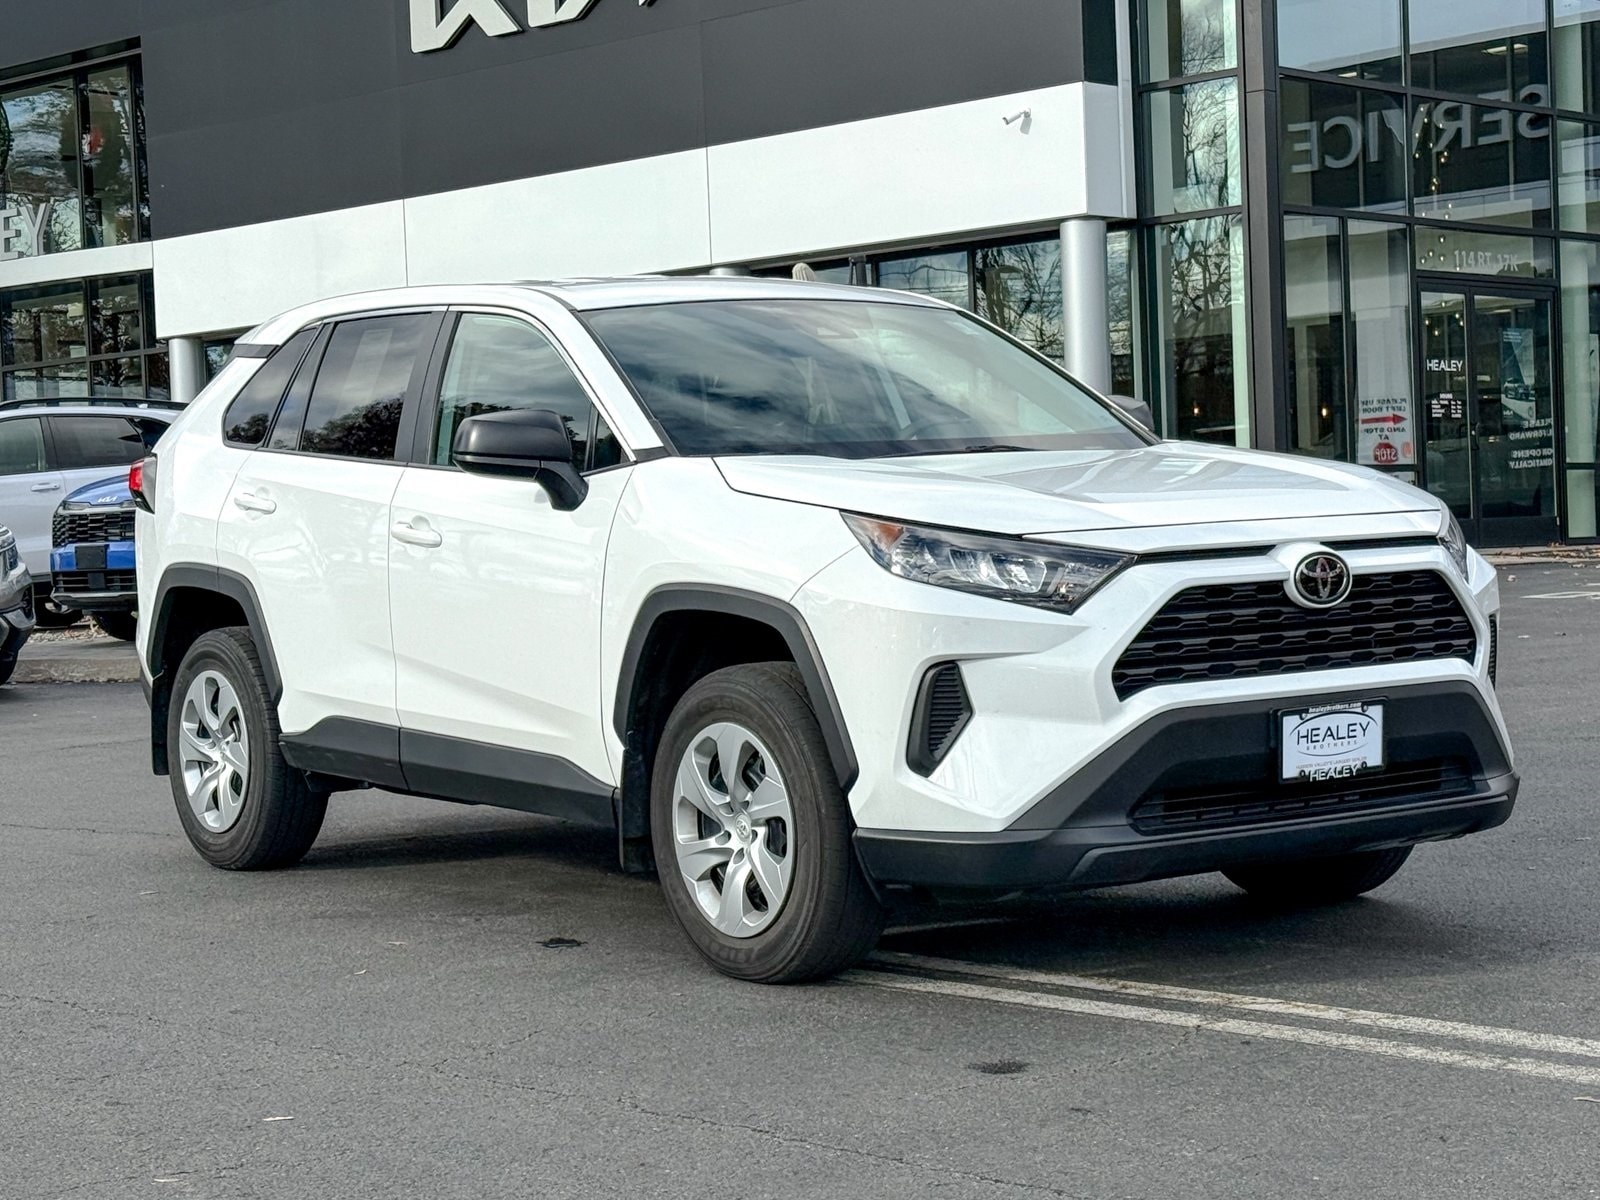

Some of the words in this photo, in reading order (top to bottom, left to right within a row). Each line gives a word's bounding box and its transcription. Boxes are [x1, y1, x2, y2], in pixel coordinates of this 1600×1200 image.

[1454, 250, 1475, 268] 114
[1426, 359, 1463, 372] HEALEY
[1297, 721, 1370, 745] HEALEY
[1306, 740, 1358, 751] BROTHERS
[1309, 764, 1359, 782] HEALEY
